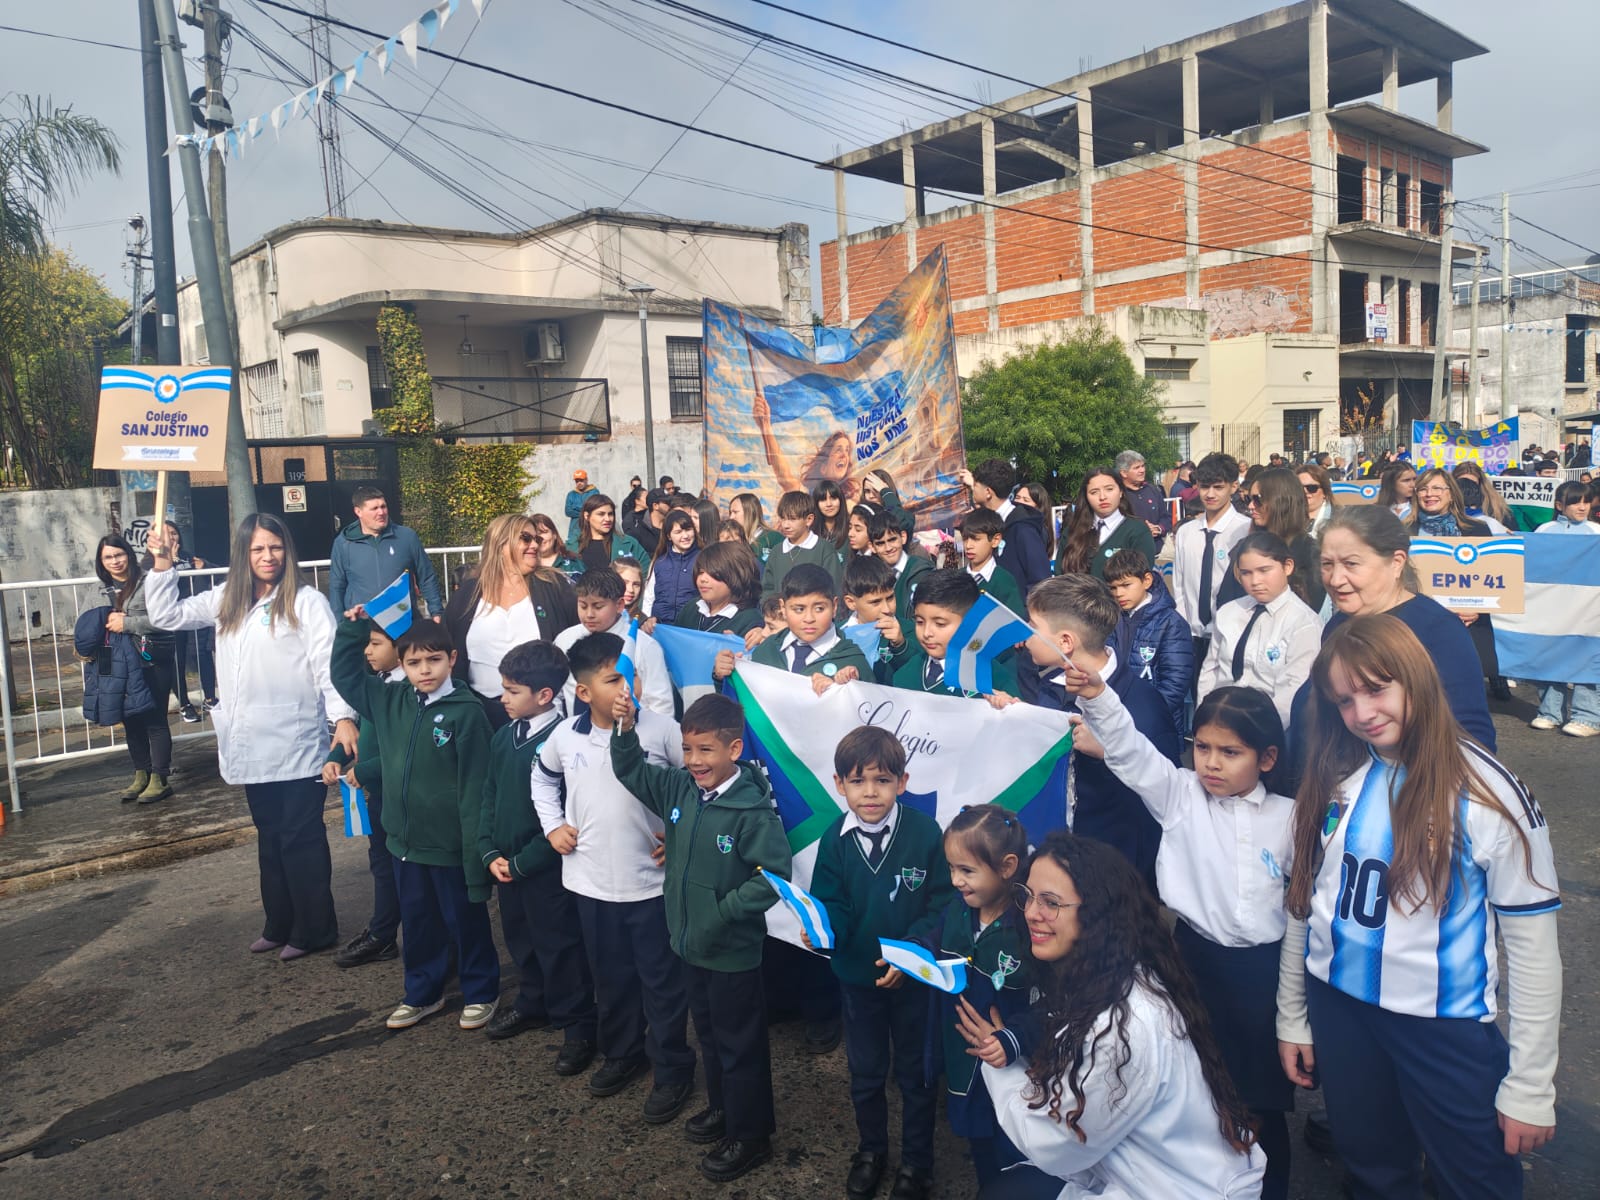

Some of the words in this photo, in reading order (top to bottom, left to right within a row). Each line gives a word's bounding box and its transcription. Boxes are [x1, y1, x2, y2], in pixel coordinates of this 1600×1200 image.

[146, 410, 188, 425] Colegio
[121, 423, 149, 436] SAN
[151, 424, 209, 437] JUSTINO
[857, 437, 880, 461] NOS
[884, 417, 908, 442] UNE
[1420, 446, 1509, 460] CUIDADO
[1527, 493, 1553, 502] XXIII
[1483, 574, 1506, 588] 41
[858, 700, 942, 767] Clegio
